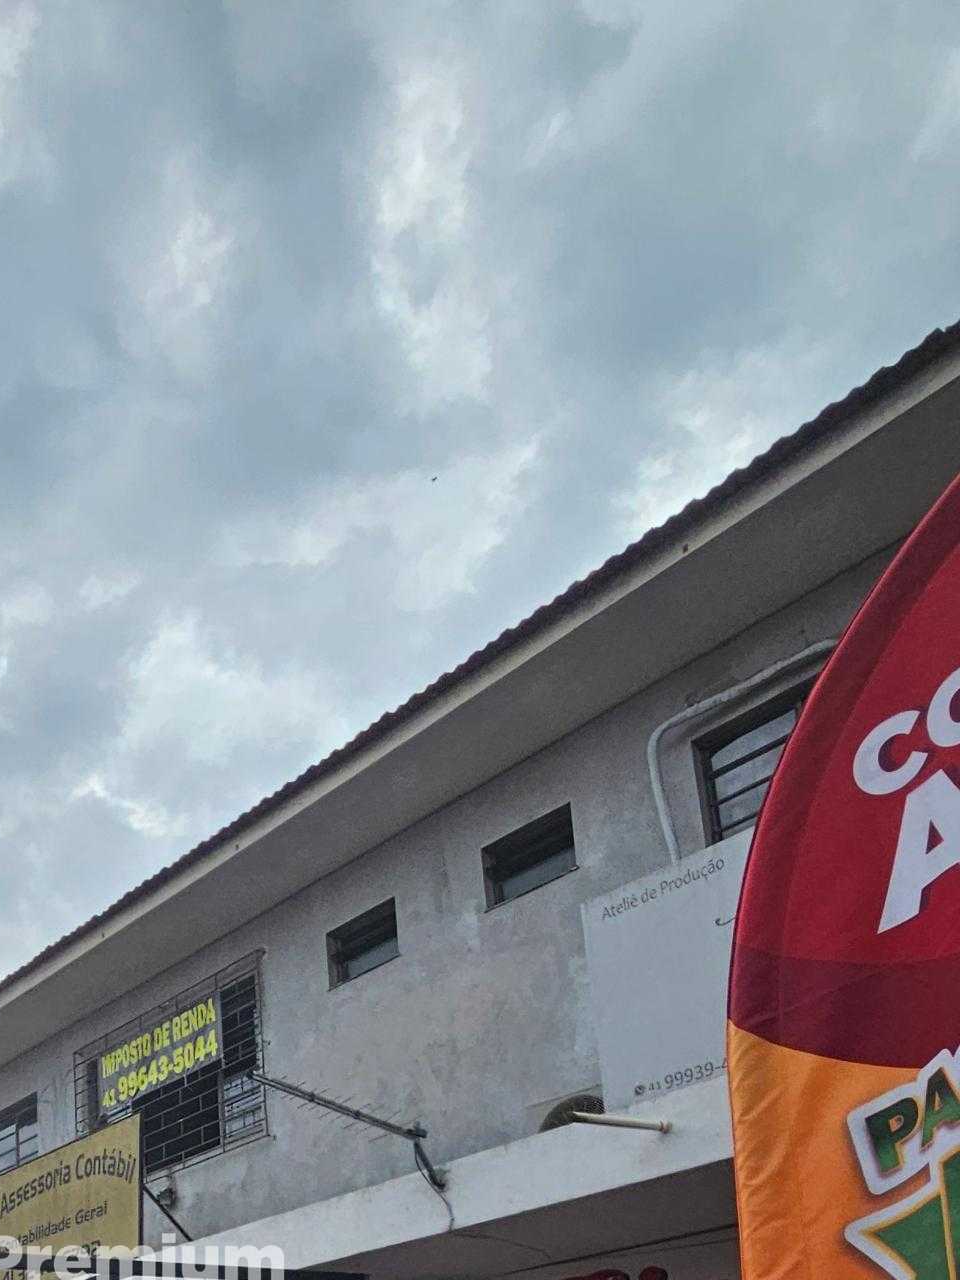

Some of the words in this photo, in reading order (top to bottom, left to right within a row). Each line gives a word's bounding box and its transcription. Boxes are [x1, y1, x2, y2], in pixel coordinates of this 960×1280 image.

[641, 888, 657, 904] de
[659, 858, 725, 895] Produção
[102, 1033, 151, 1078] IMPOSTO
[153, 1021, 170, 1051] DE
[172, 998, 216, 1042] RENDA
[118, 1029, 218, 1101] 99643-5044
[0, 1161, 71, 1218] Assessoria
[75, 1149, 137, 1185] Contábil
[75, 1200, 108, 1225] Geral
